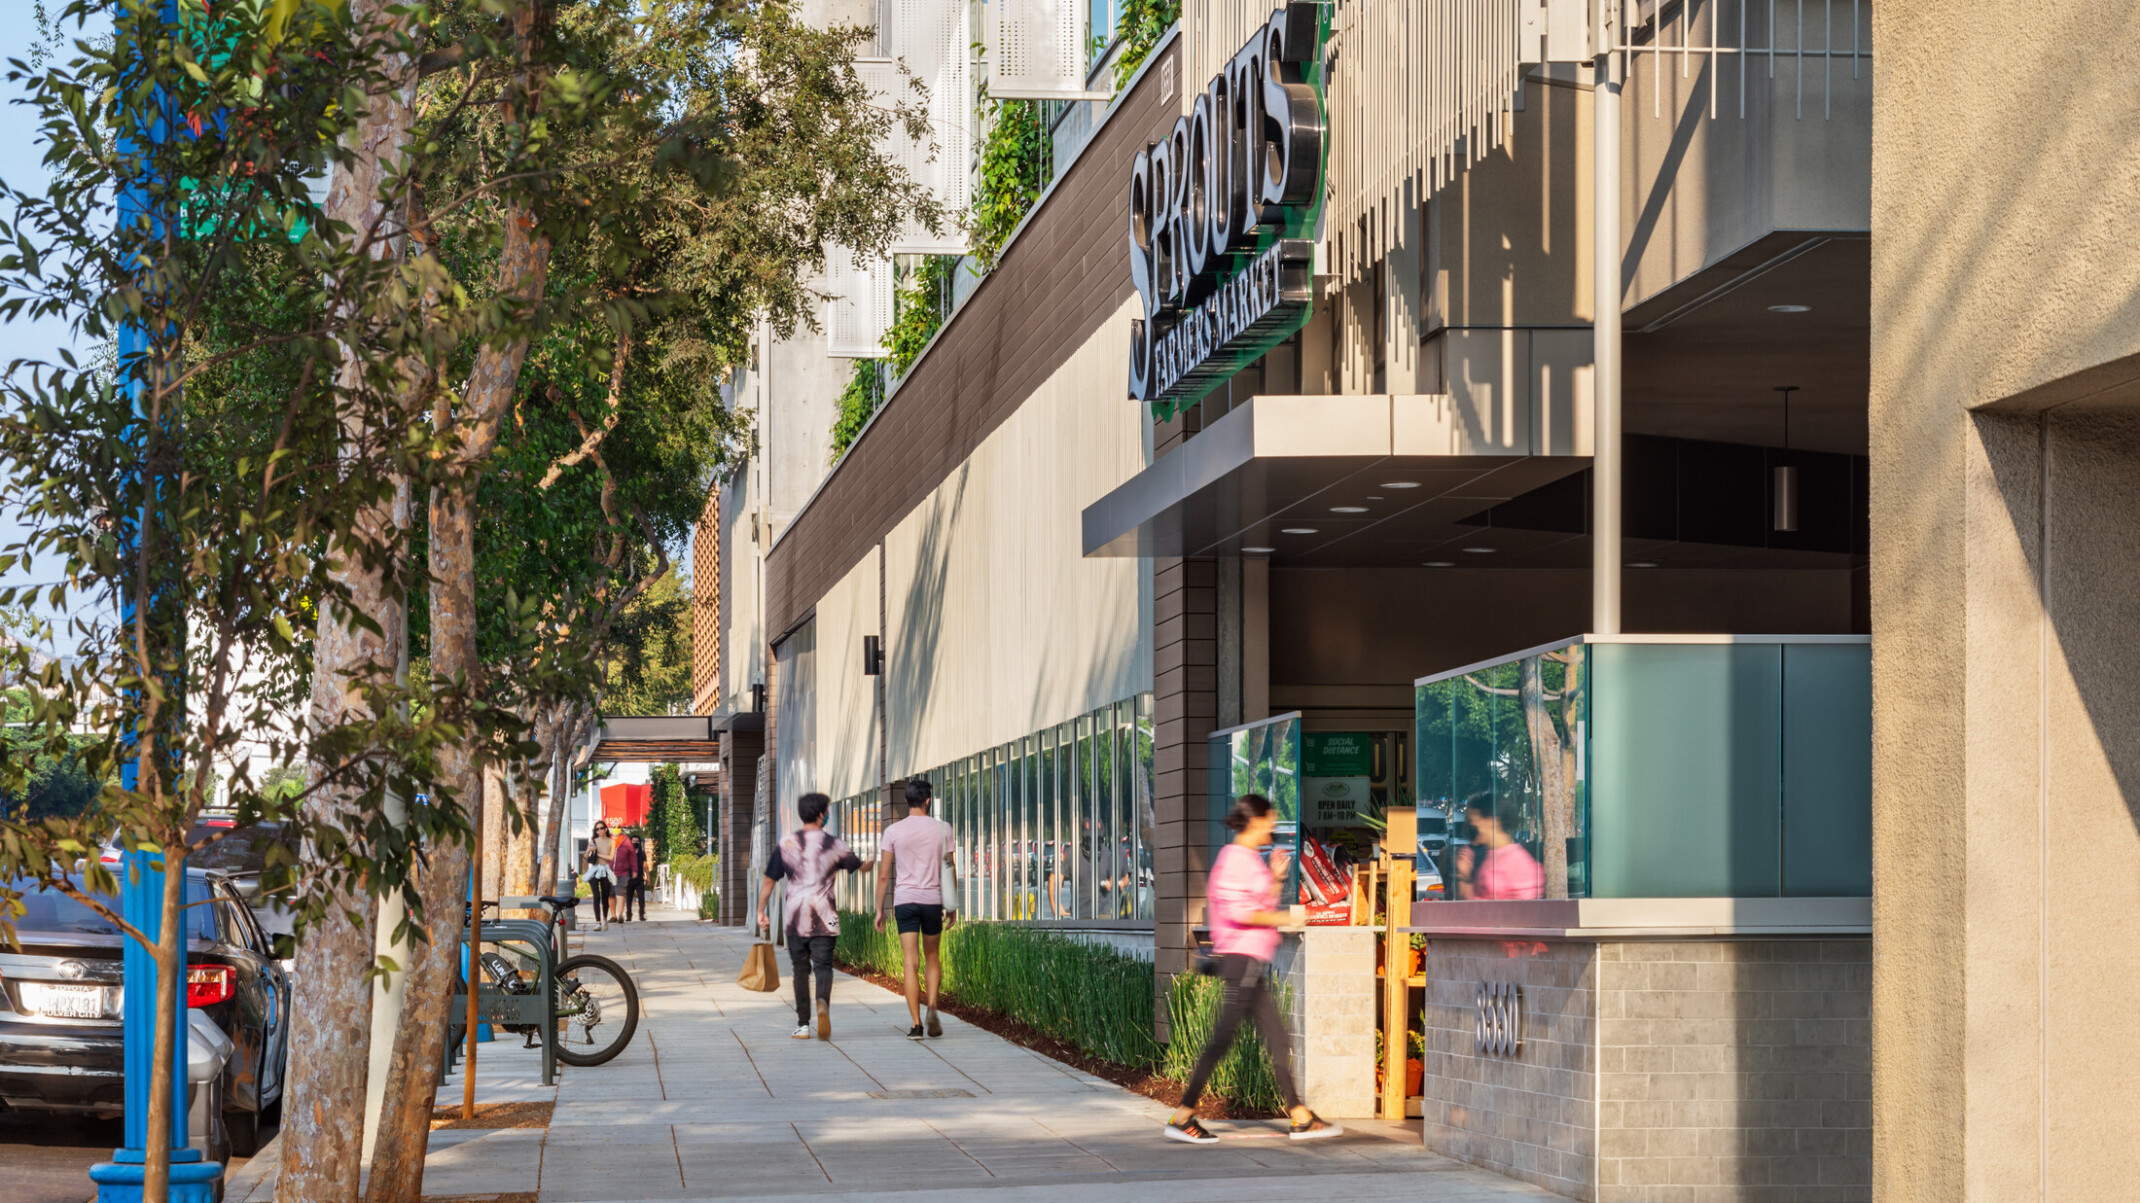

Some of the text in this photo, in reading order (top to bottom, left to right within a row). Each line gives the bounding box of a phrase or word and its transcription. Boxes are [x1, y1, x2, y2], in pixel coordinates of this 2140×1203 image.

[1129, 3, 1292, 401] SPROUTS
[1154, 239, 1282, 399] FARMERS MARKET
[1327, 738, 1354, 746] SOCIAL
[1323, 746, 1359, 755] DISTANCE
[1318, 800, 1356, 810] OPEN DAILY
[1346, 811, 1356, 820] PM
[491, 959, 507, 977] LUN
[1475, 980, 1519, 1057] 8550
